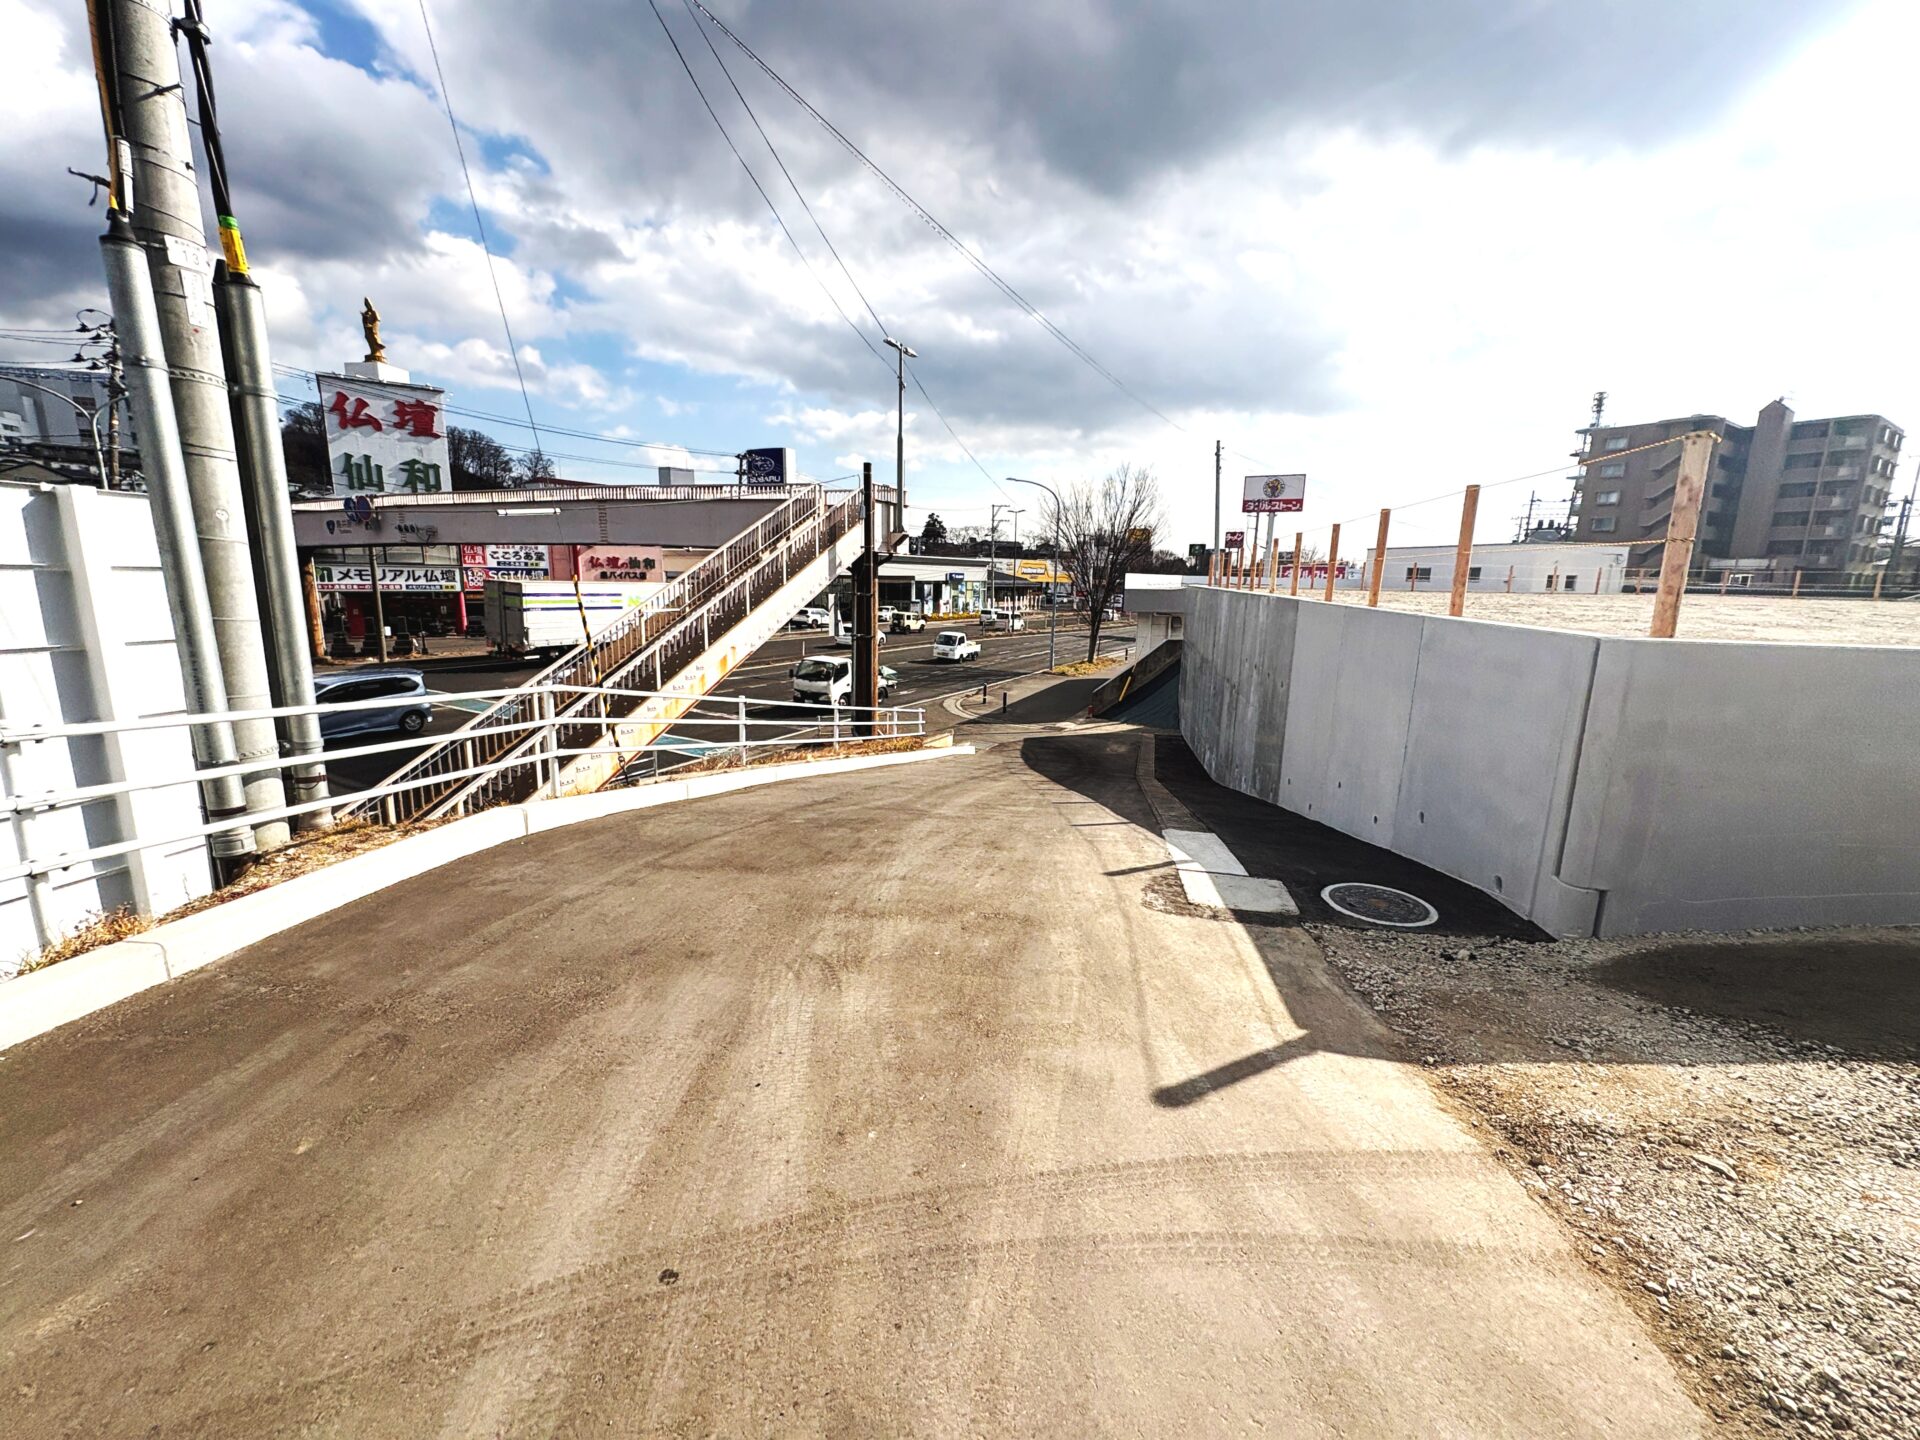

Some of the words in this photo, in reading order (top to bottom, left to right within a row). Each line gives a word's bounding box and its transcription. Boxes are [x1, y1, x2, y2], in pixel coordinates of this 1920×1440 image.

[329, 391, 442, 439] 仏壇
[340, 452, 442, 493] 仙和
[750, 475, 781, 483] SUBARU
[464, 546, 484, 555] 仏壇
[588, 555, 656, 570] 仏壇の仙和
